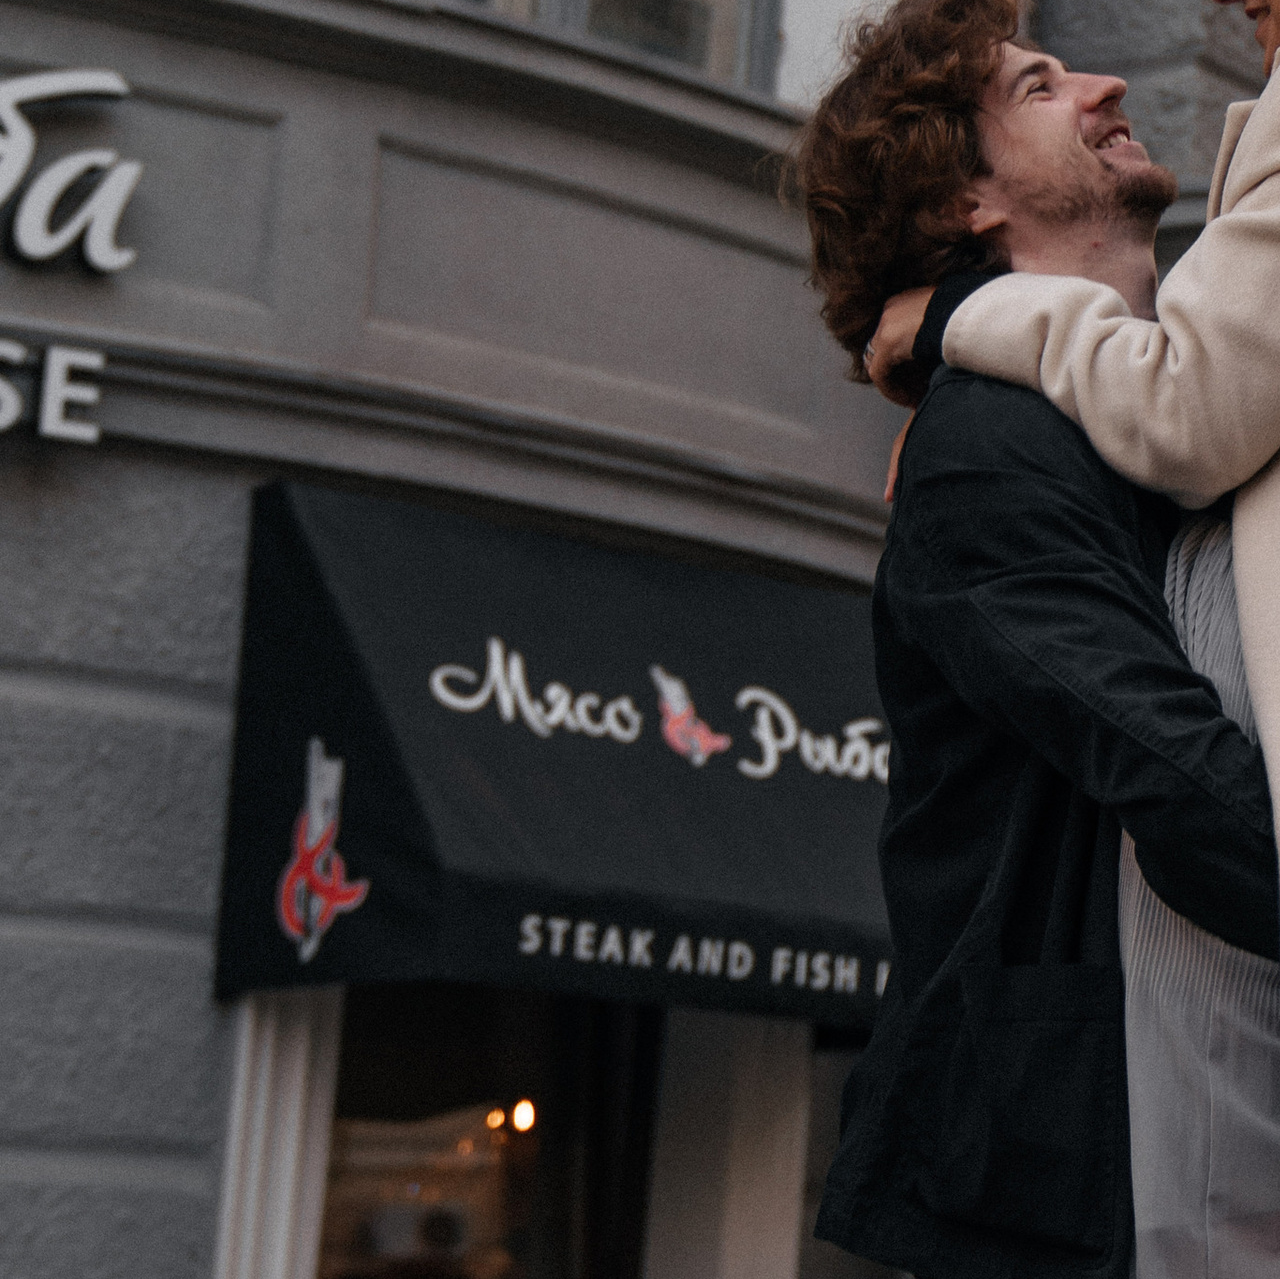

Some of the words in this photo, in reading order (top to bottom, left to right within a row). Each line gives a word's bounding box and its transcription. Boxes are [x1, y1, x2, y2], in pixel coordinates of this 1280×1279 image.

[428, 635, 643, 744] Мясо
[518, 914, 654, 968] STEAK
[667, 933, 756, 981] AND
[770, 946, 859, 994] FISH
